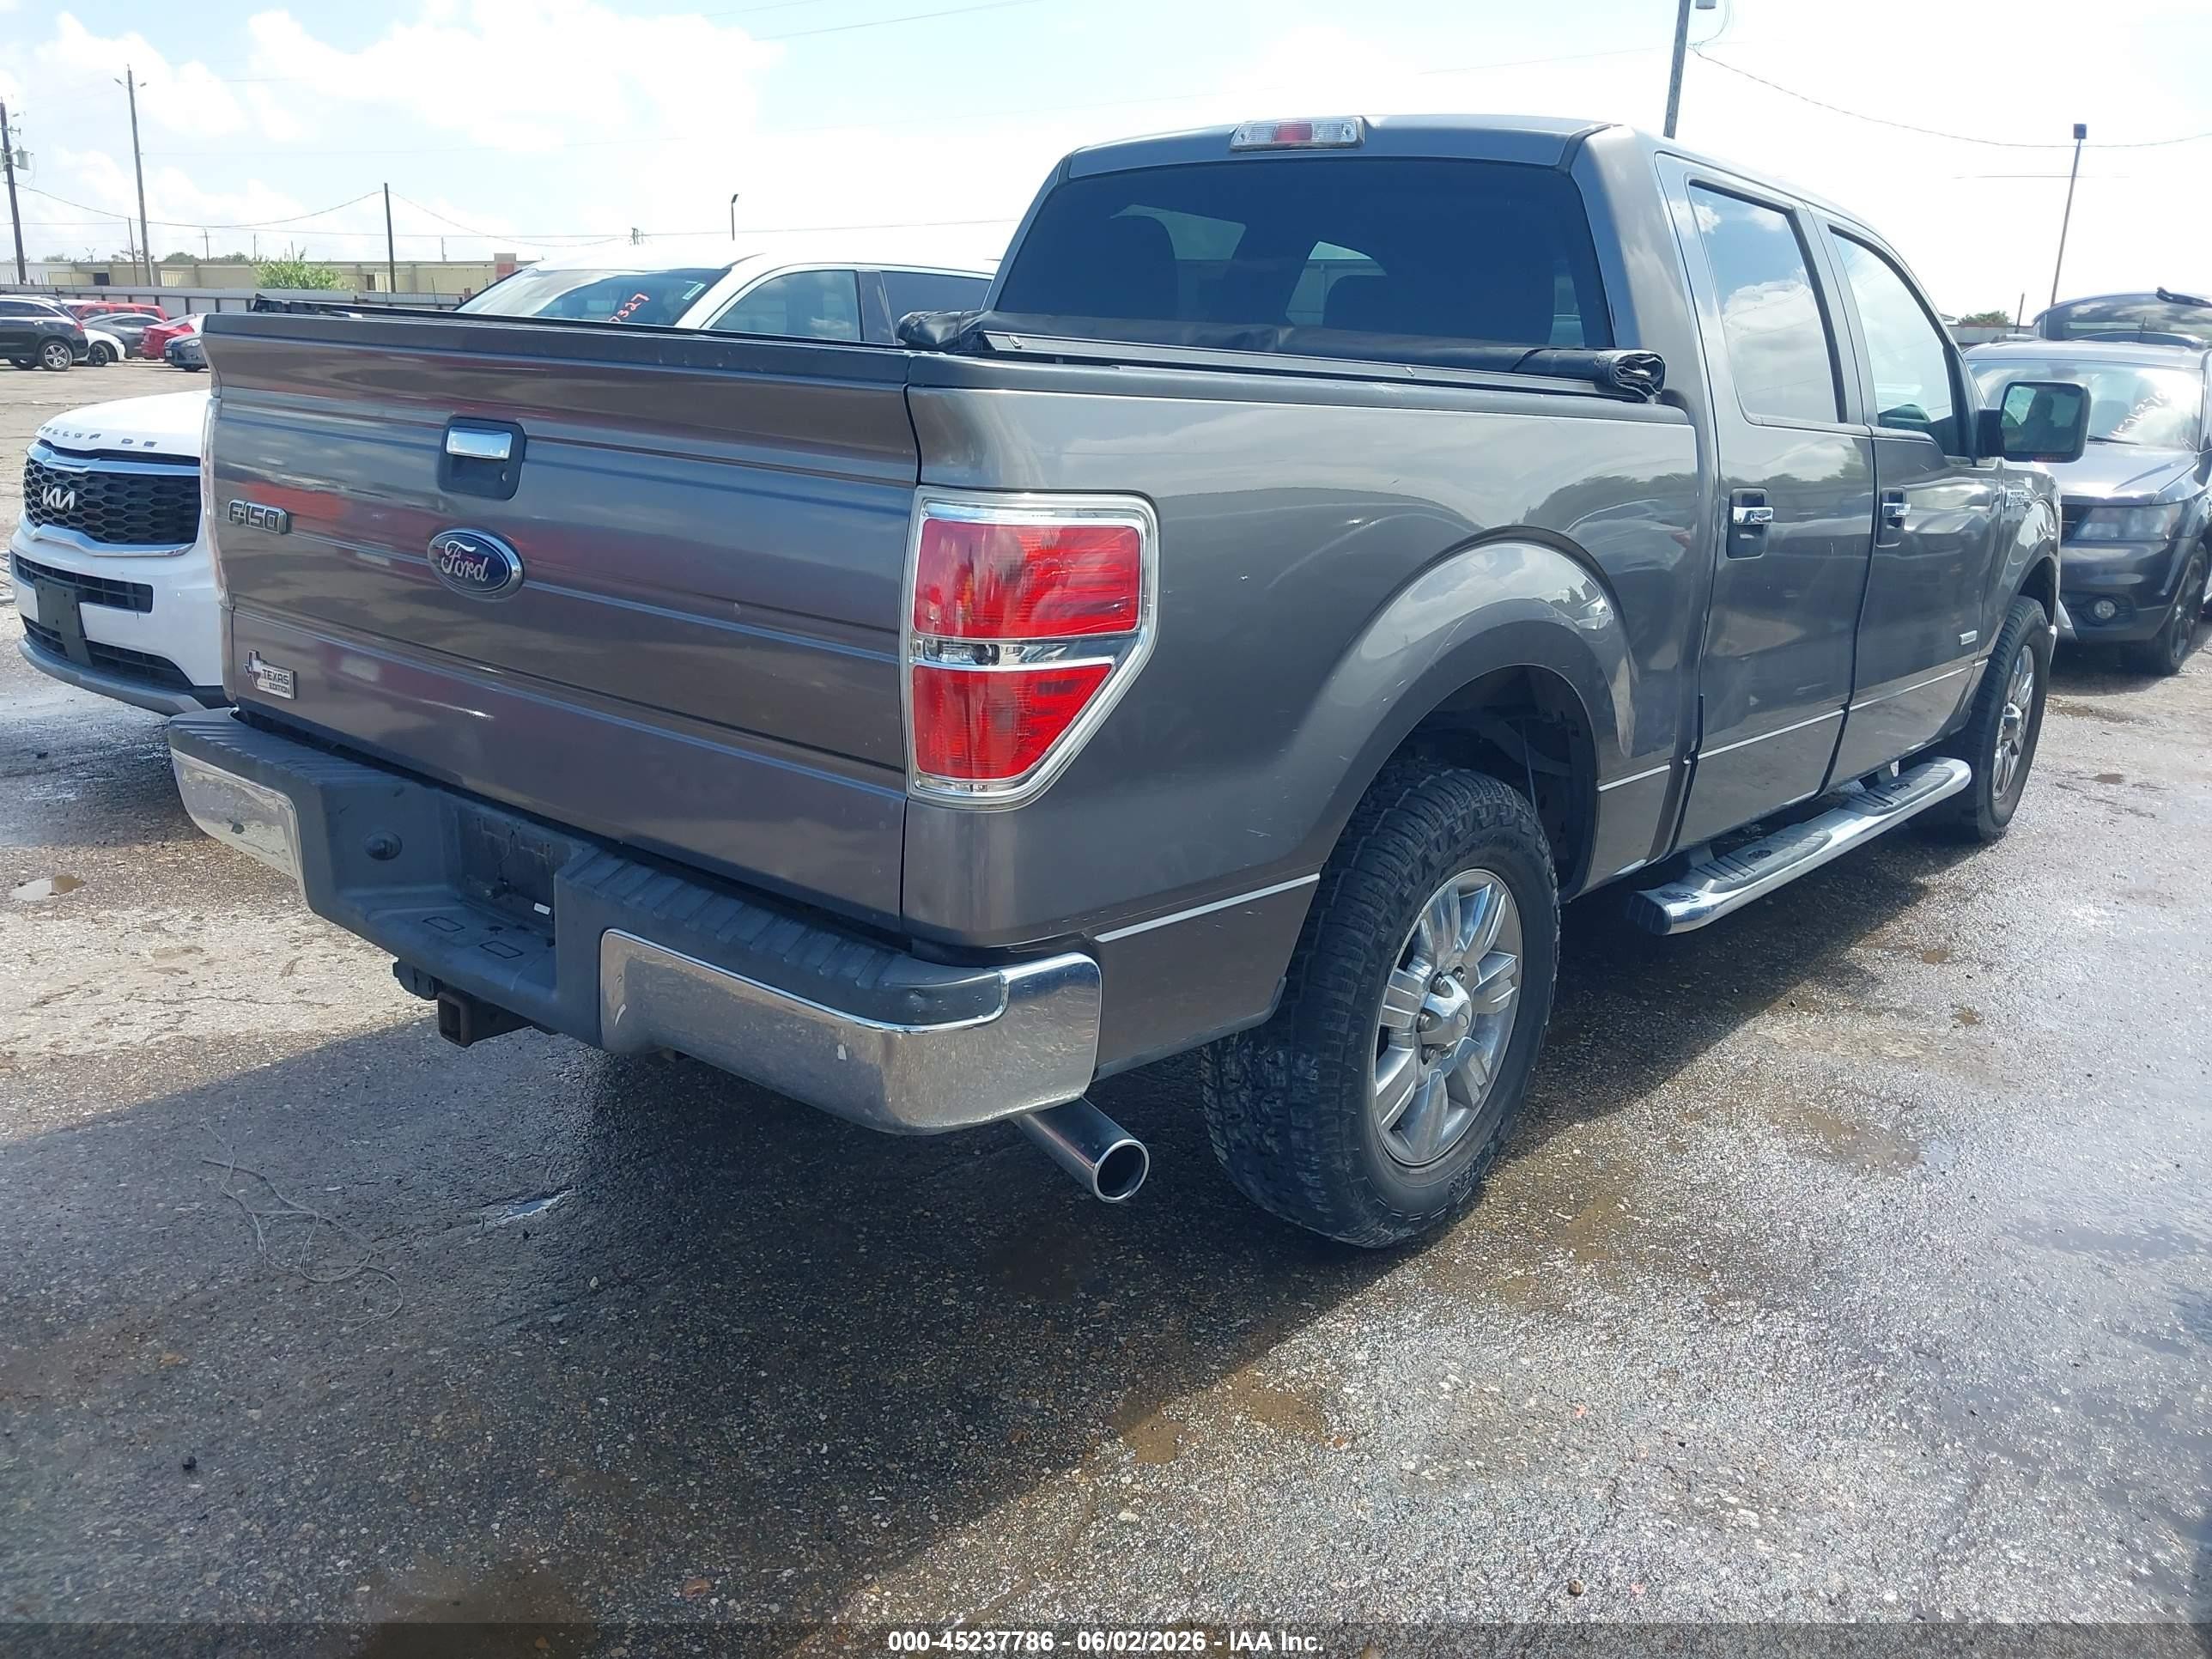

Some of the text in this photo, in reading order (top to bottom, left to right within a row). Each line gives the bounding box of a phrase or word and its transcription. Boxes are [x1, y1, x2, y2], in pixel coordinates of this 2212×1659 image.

[40, 426, 158, 448] TELLURDE
[42, 486, 76, 511] KIA
[441, 540, 489, 582] Ford
[262, 668, 289, 686] TEXAS
